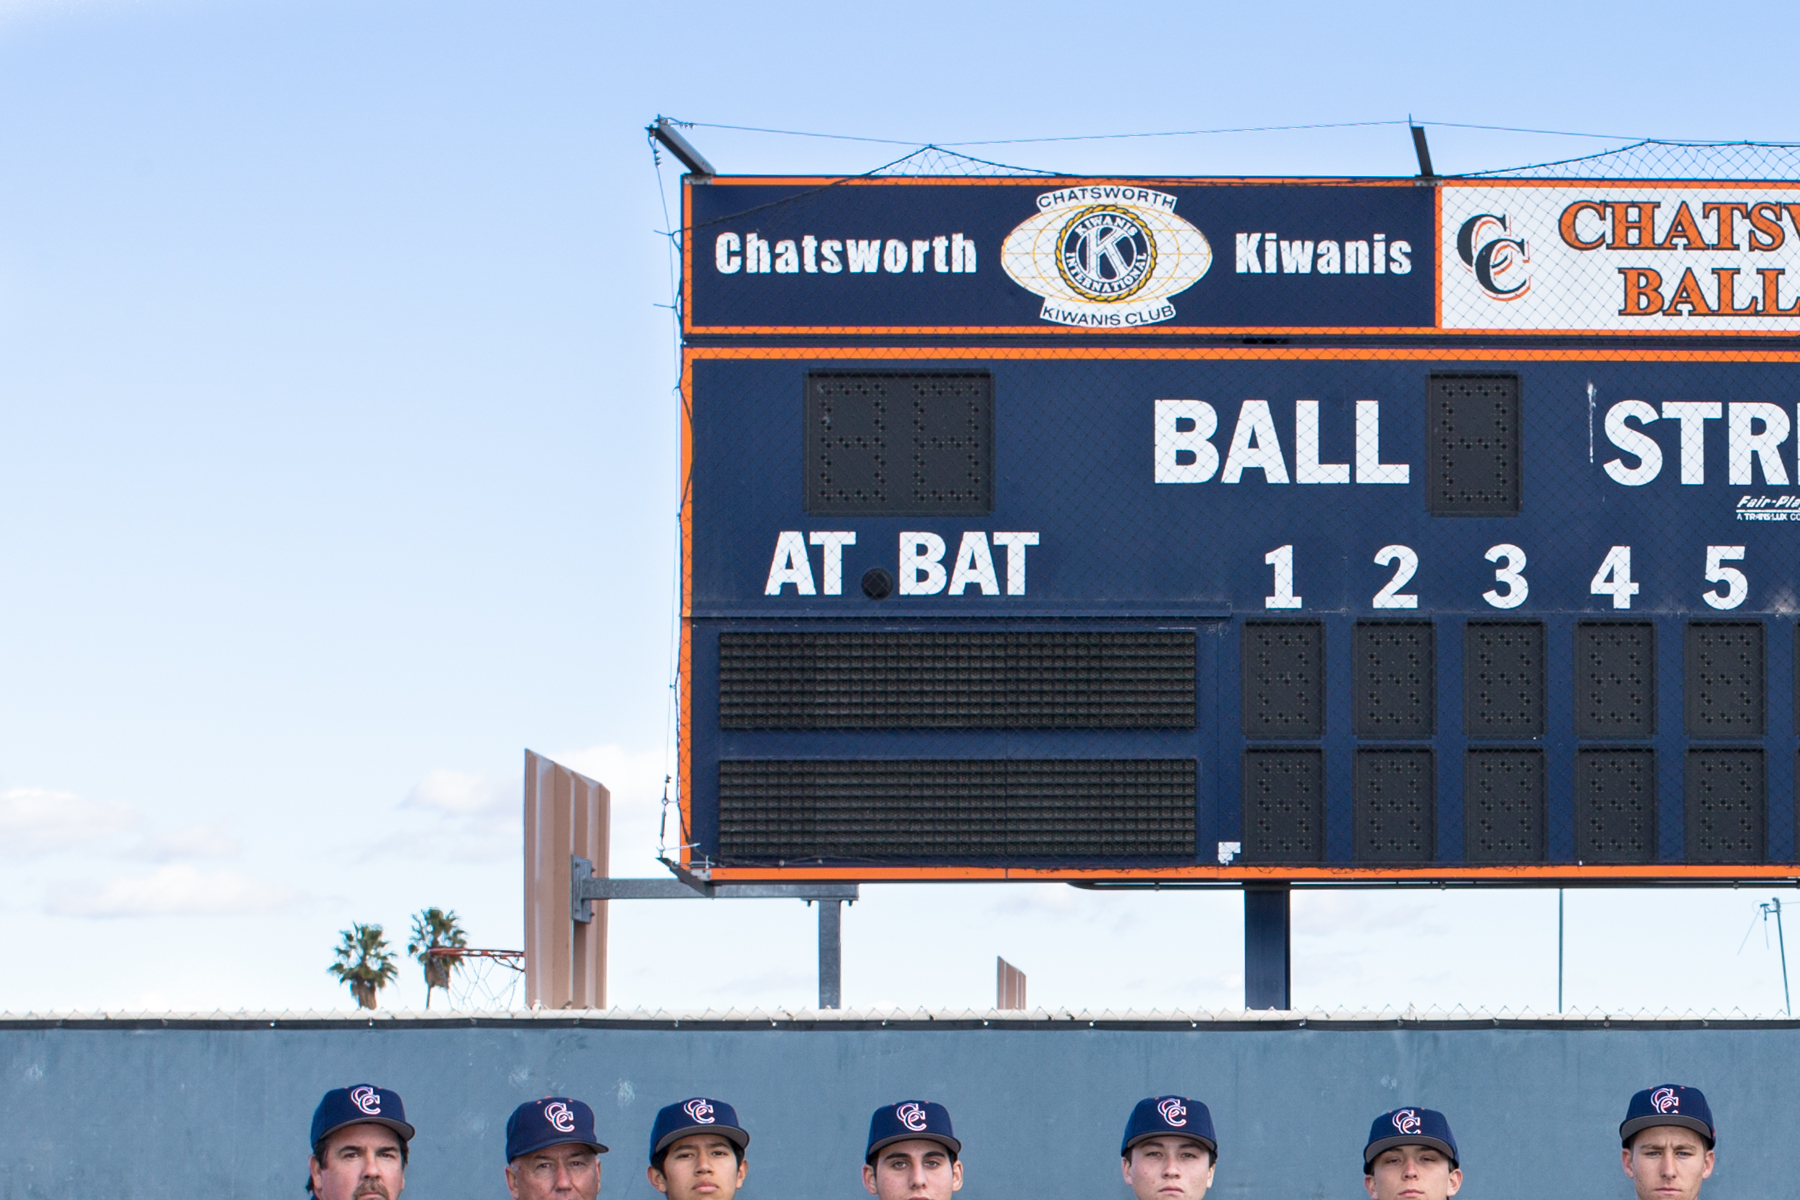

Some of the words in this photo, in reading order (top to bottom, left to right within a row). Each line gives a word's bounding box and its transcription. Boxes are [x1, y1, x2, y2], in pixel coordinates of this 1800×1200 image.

[1037, 186, 1175, 209] CHATSWORTH
[1074, 215, 1139, 238] KIWANIS
[715, 232, 977, 274] Chatsworth
[1235, 232, 1412, 274] Kiwanis
[1066, 252, 1148, 294] INTERNATIONAL
[1042, 305, 1121, 326] KIWANIS
[1125, 304, 1174, 325] CLUB
[1154, 399, 1410, 484] BALL
[1736, 513, 1743, 521] A
[764, 531, 856, 596] AT
[899, 531, 1040, 596] BAT
[1265, 544, 1302, 609] 1
[1372, 545, 1419, 609] 2
[1482, 543, 1529, 609] 3
[1590, 545, 1640, 609] 4
[1702, 545, 1748, 610] 5
